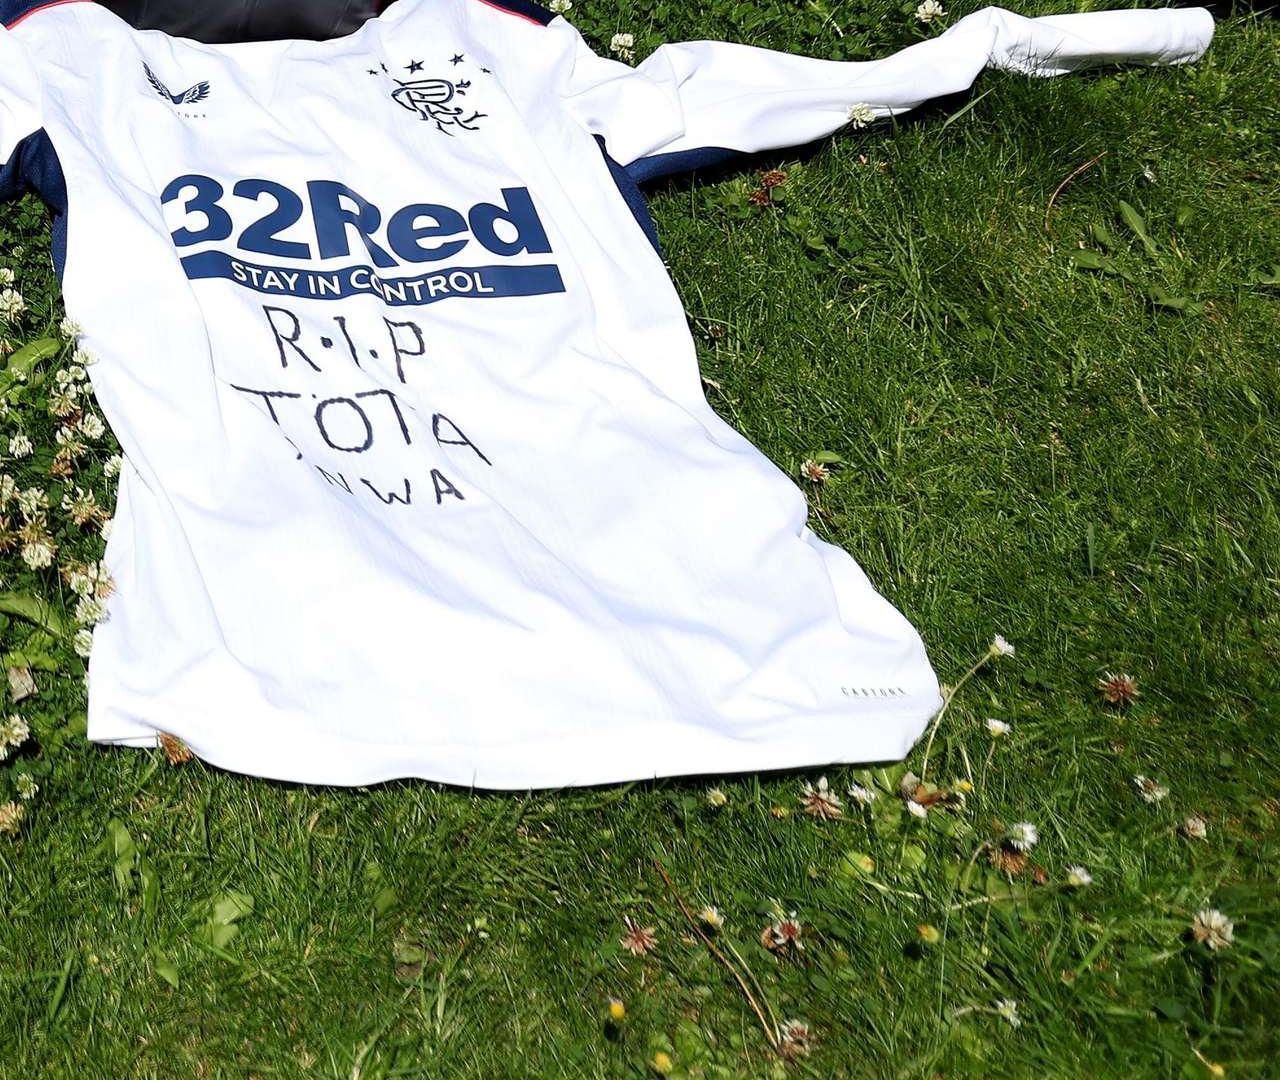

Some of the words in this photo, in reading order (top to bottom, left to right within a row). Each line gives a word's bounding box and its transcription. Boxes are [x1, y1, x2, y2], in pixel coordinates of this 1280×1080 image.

[160, 173, 554, 268] 32Red
[230, 260, 299, 292] STAY
[307, 274, 341, 296] IN
[349, 268, 495, 302] CONTROL
[297, 453, 466, 505] NWA
